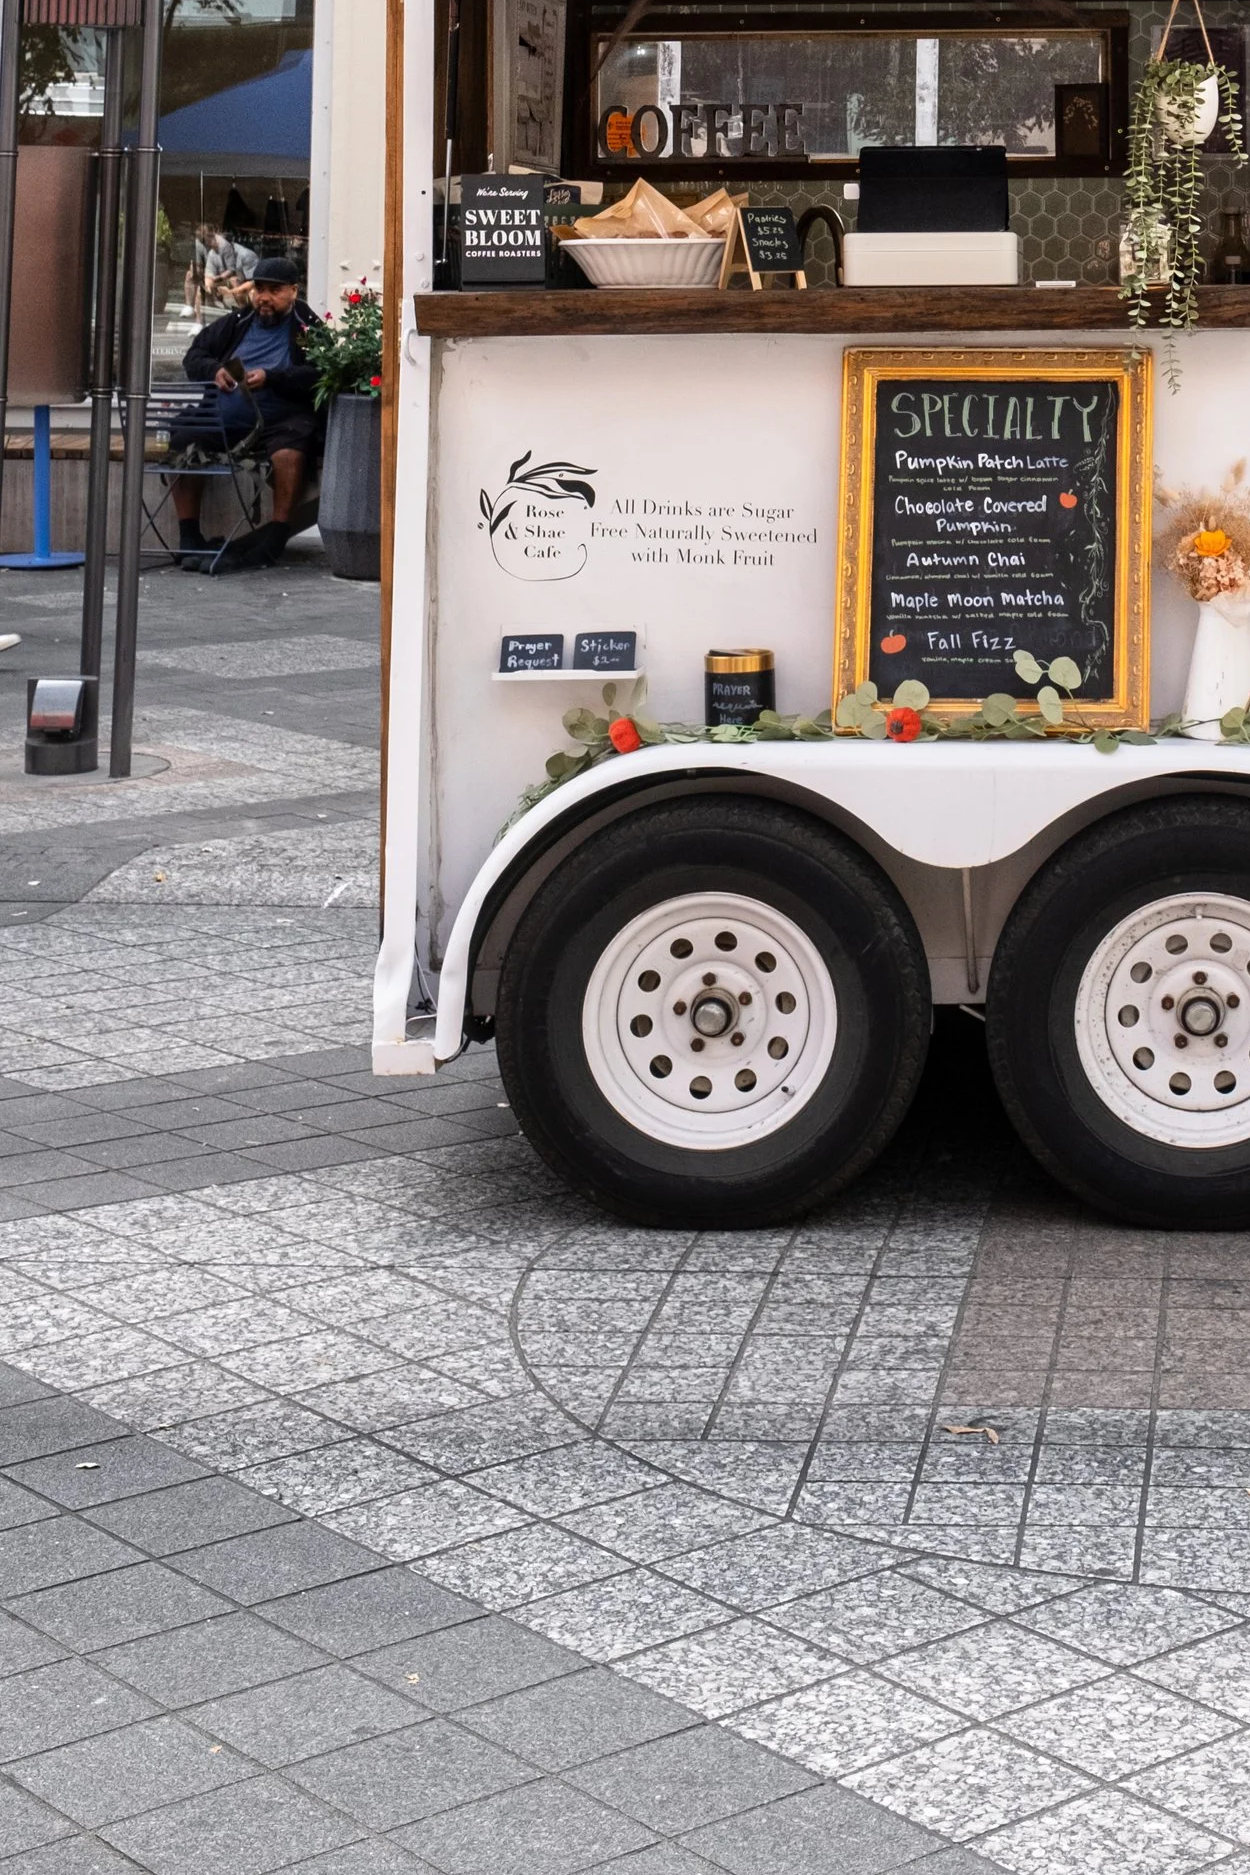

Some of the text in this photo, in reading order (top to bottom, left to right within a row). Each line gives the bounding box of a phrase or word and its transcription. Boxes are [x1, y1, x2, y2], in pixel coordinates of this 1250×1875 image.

[597, 105, 803, 158] COFFEE
[476, 187, 528, 200] We're Serving
[465, 209, 540, 225] SWEET
[465, 230, 541, 246] BLOOM
[891, 393, 1098, 443] SPECIALTY
[895, 450, 1069, 475] Pumpkin Patch Latte
[526, 505, 565, 518] Rose
[611, 499, 794, 523] All Drinks are Sugar
[895, 495, 1047, 515] Chocolate Covered
[505, 522, 565, 540] & Shae
[591, 522, 817, 546] Free Naturally Sweetened
[936, 519, 1012, 536] Pumpkin
[524, 545, 561, 558] Cafe
[631, 547, 775, 566] with Monk Fruit
[906, 552, 1026, 567] Autumn Chai
[891, 592, 938, 612] Maple
[948, 594, 994, 607] Moon
[508, 641, 552, 654] Prayer
[581, 639, 630, 653] Sticker
[927, 631, 1016, 650] Fall Fizz
[507, 654, 560, 670] Request
[713, 683, 751, 695] PRAYER
[720, 714, 743, 724] Here
